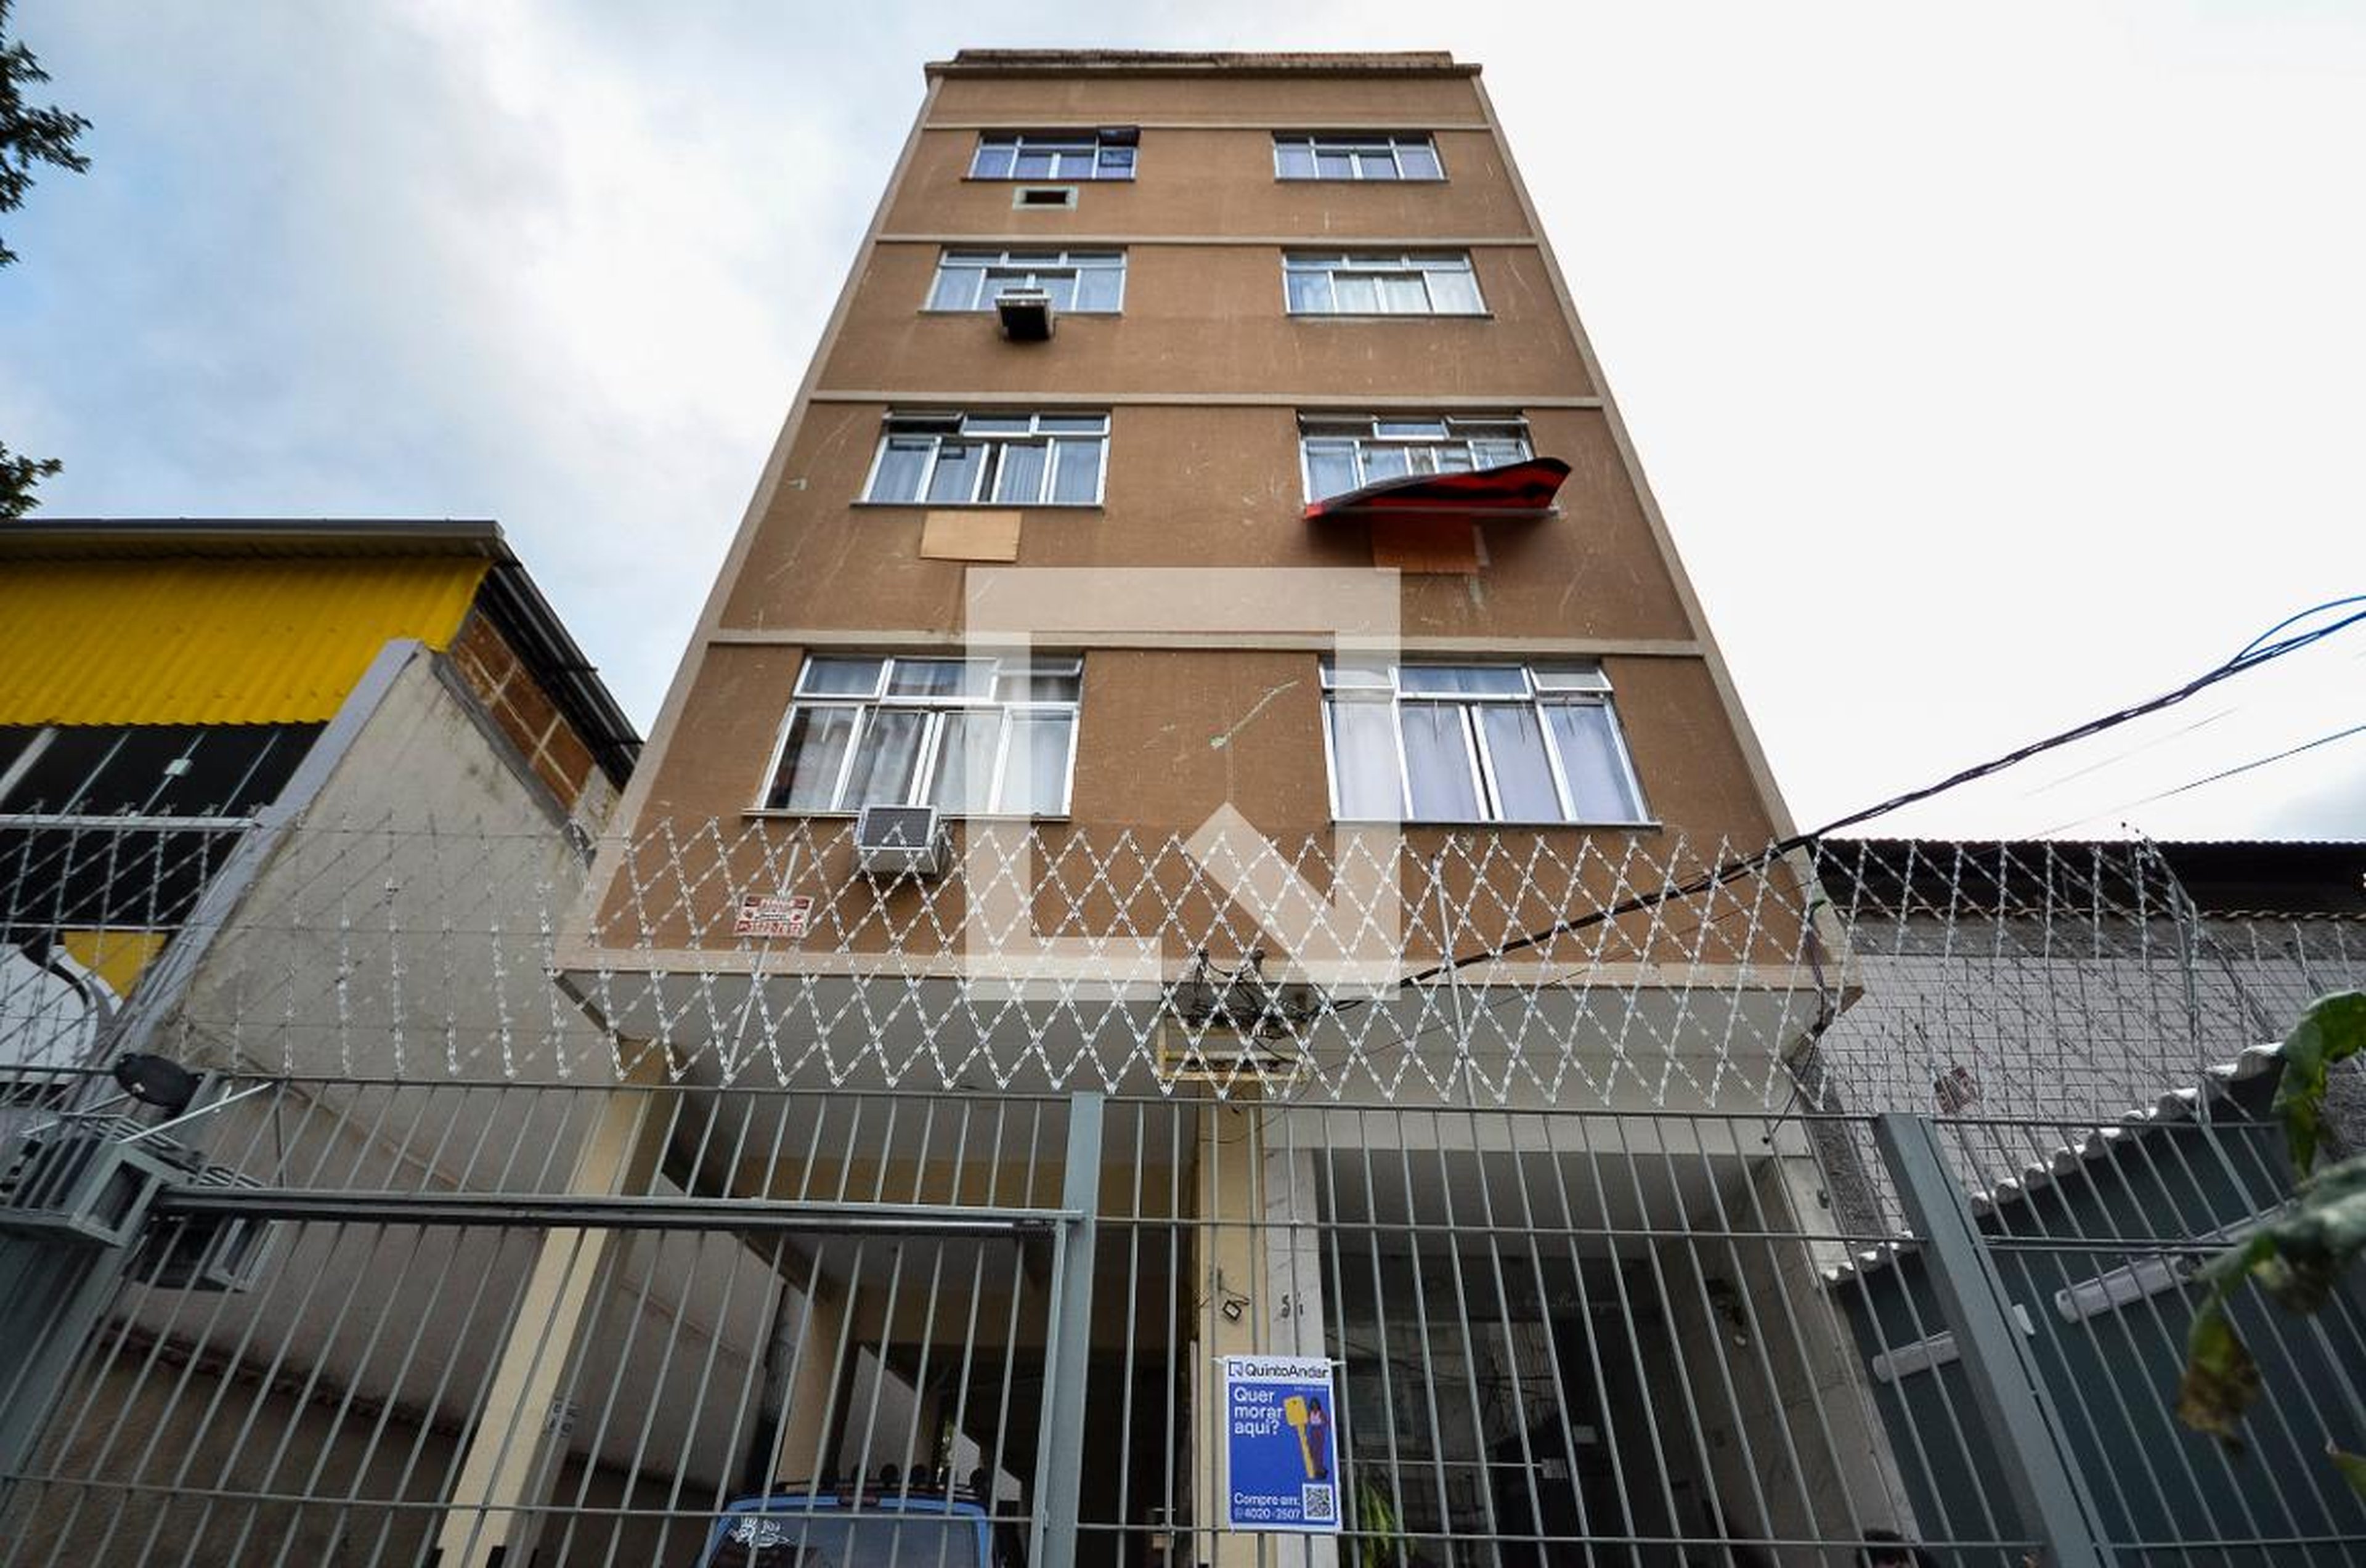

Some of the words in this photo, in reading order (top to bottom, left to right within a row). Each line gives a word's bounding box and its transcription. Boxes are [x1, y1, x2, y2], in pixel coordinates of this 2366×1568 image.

[1245, 1362, 1329, 1378] QuintoAndar
[1234, 1387, 1275, 1403] Quer
[1234, 1405, 1283, 1419] morar
[1234, 1419, 1280, 1437] aqui?
